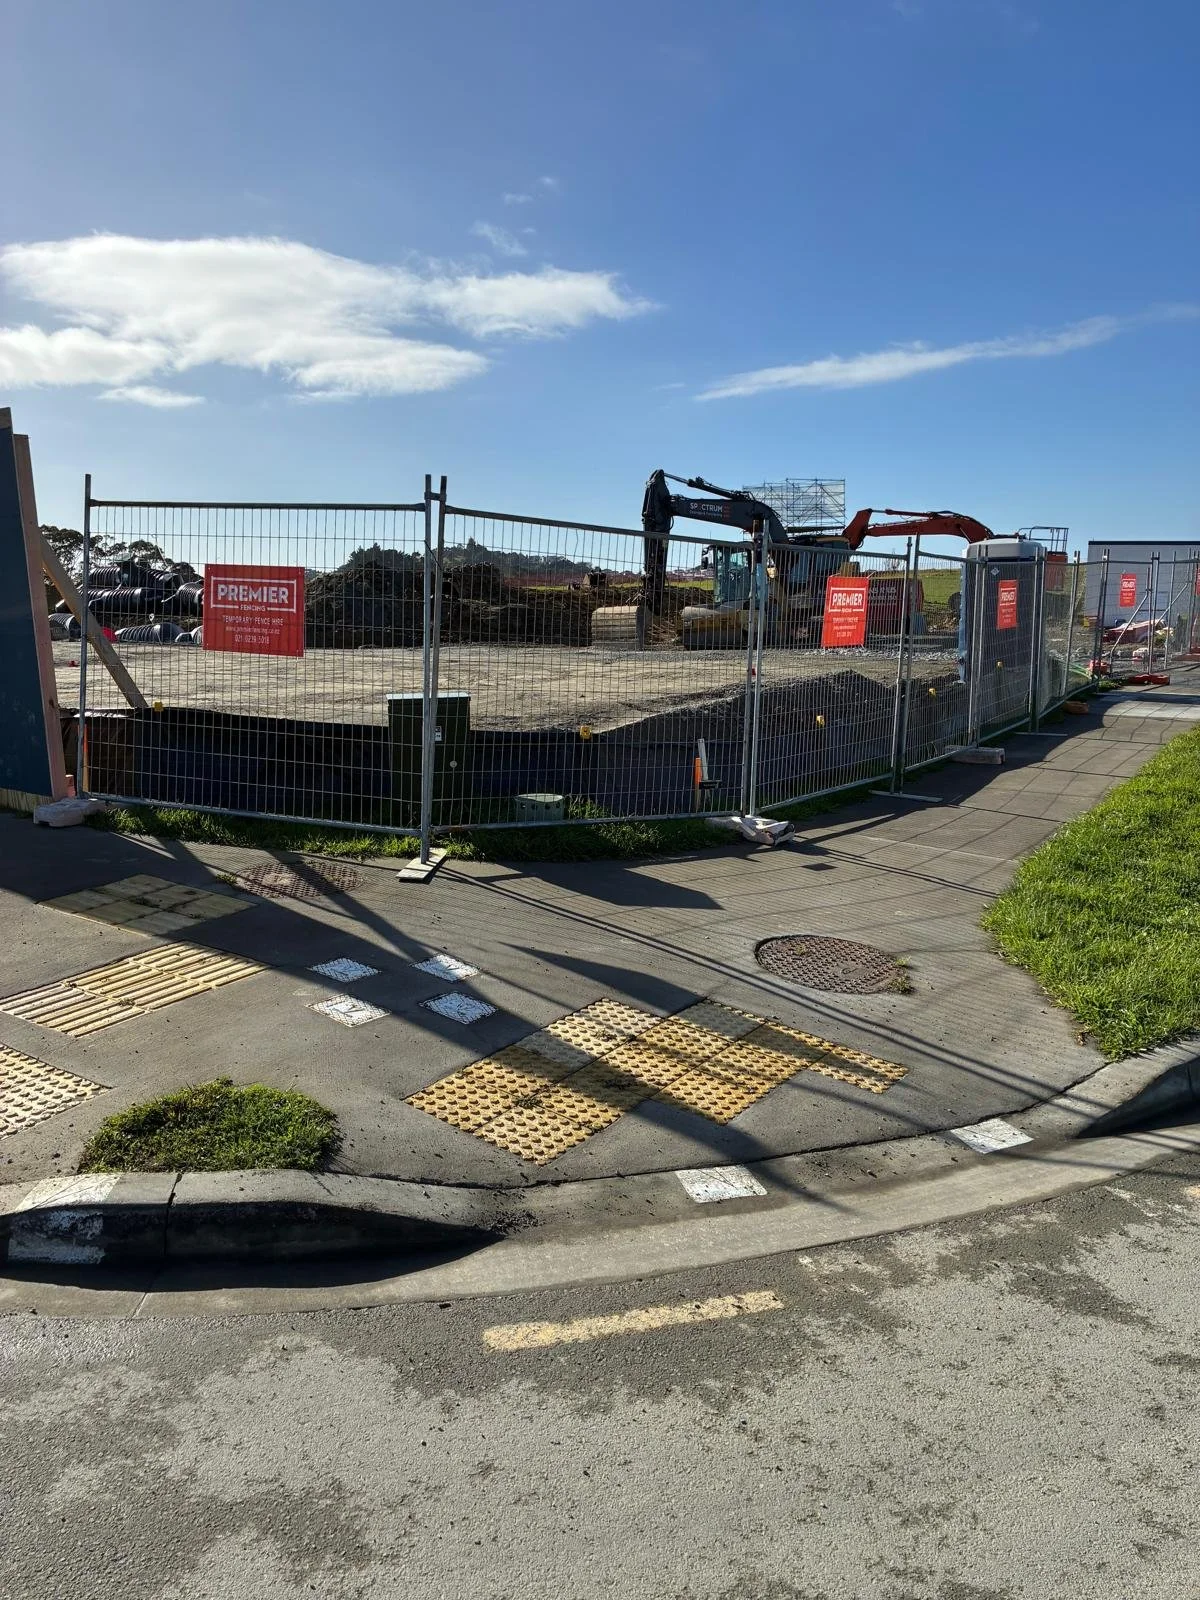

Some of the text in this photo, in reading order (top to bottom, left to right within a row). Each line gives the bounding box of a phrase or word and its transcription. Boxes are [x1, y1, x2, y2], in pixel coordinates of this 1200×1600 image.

[690, 502, 723, 512] SPCTRUM
[217, 583, 289, 604] PREMIER
[832, 592, 863, 607] PREMIER
[240, 604, 266, 612] FENCING
[222, 615, 252, 624] TEMPORARY
[254, 616, 270, 625] FENCE
